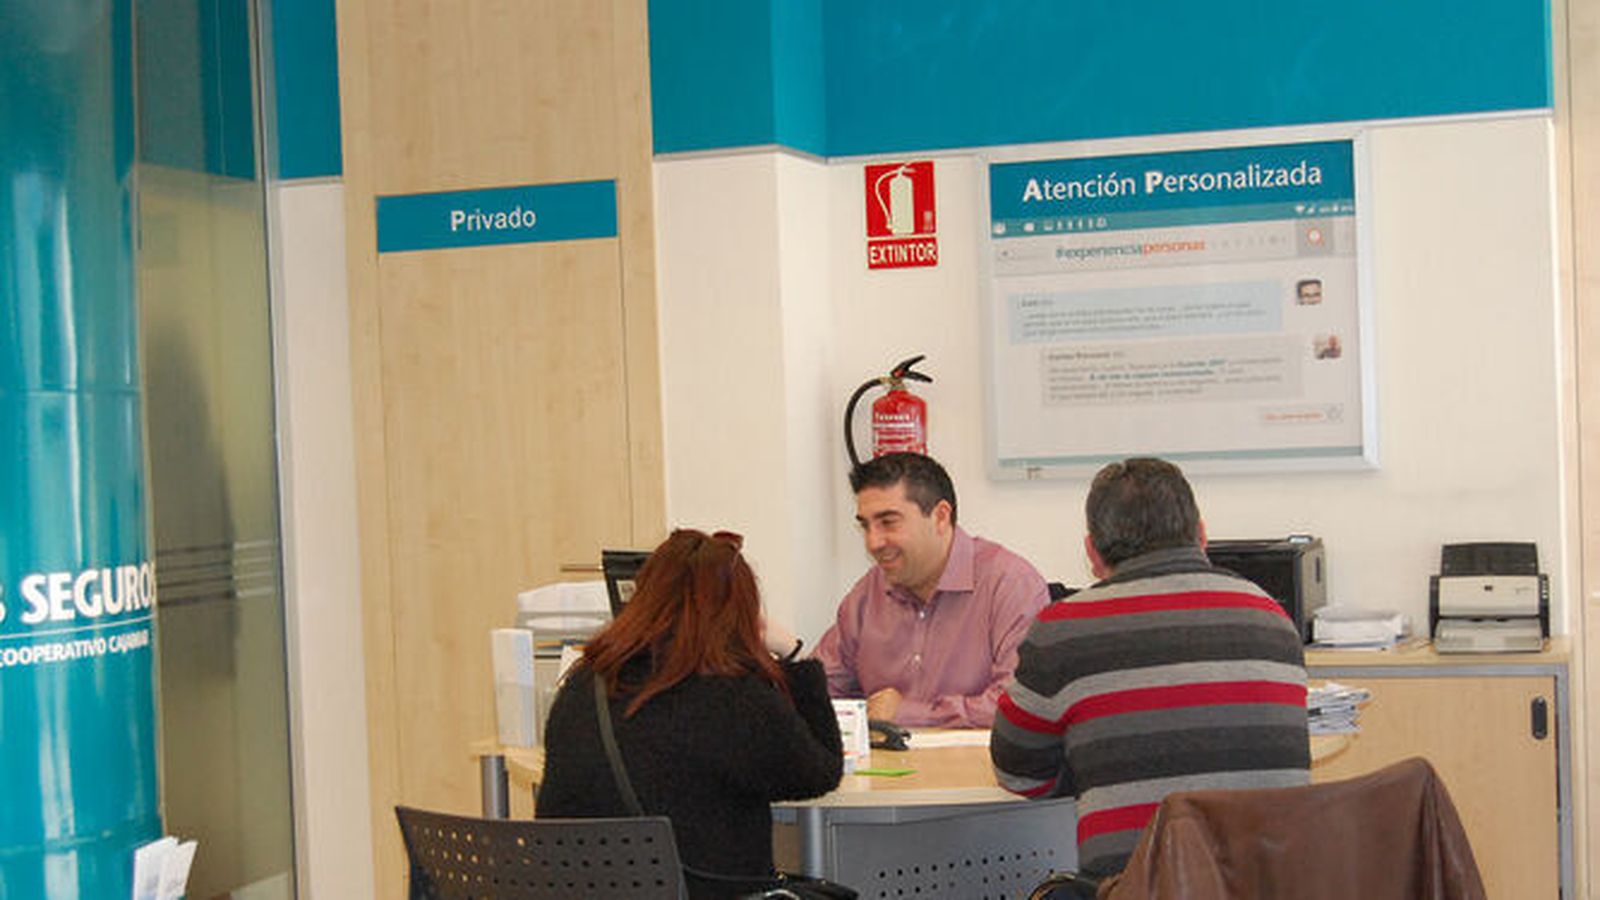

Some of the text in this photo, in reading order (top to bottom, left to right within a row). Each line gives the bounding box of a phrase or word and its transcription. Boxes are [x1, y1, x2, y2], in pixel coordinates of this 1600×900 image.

[1022, 160, 1322, 203] Atención Personalizada
[451, 205, 537, 232] Privado
[870, 243, 938, 264] EXTINTOR
[0, 638, 107, 668] OOPERATIVO
